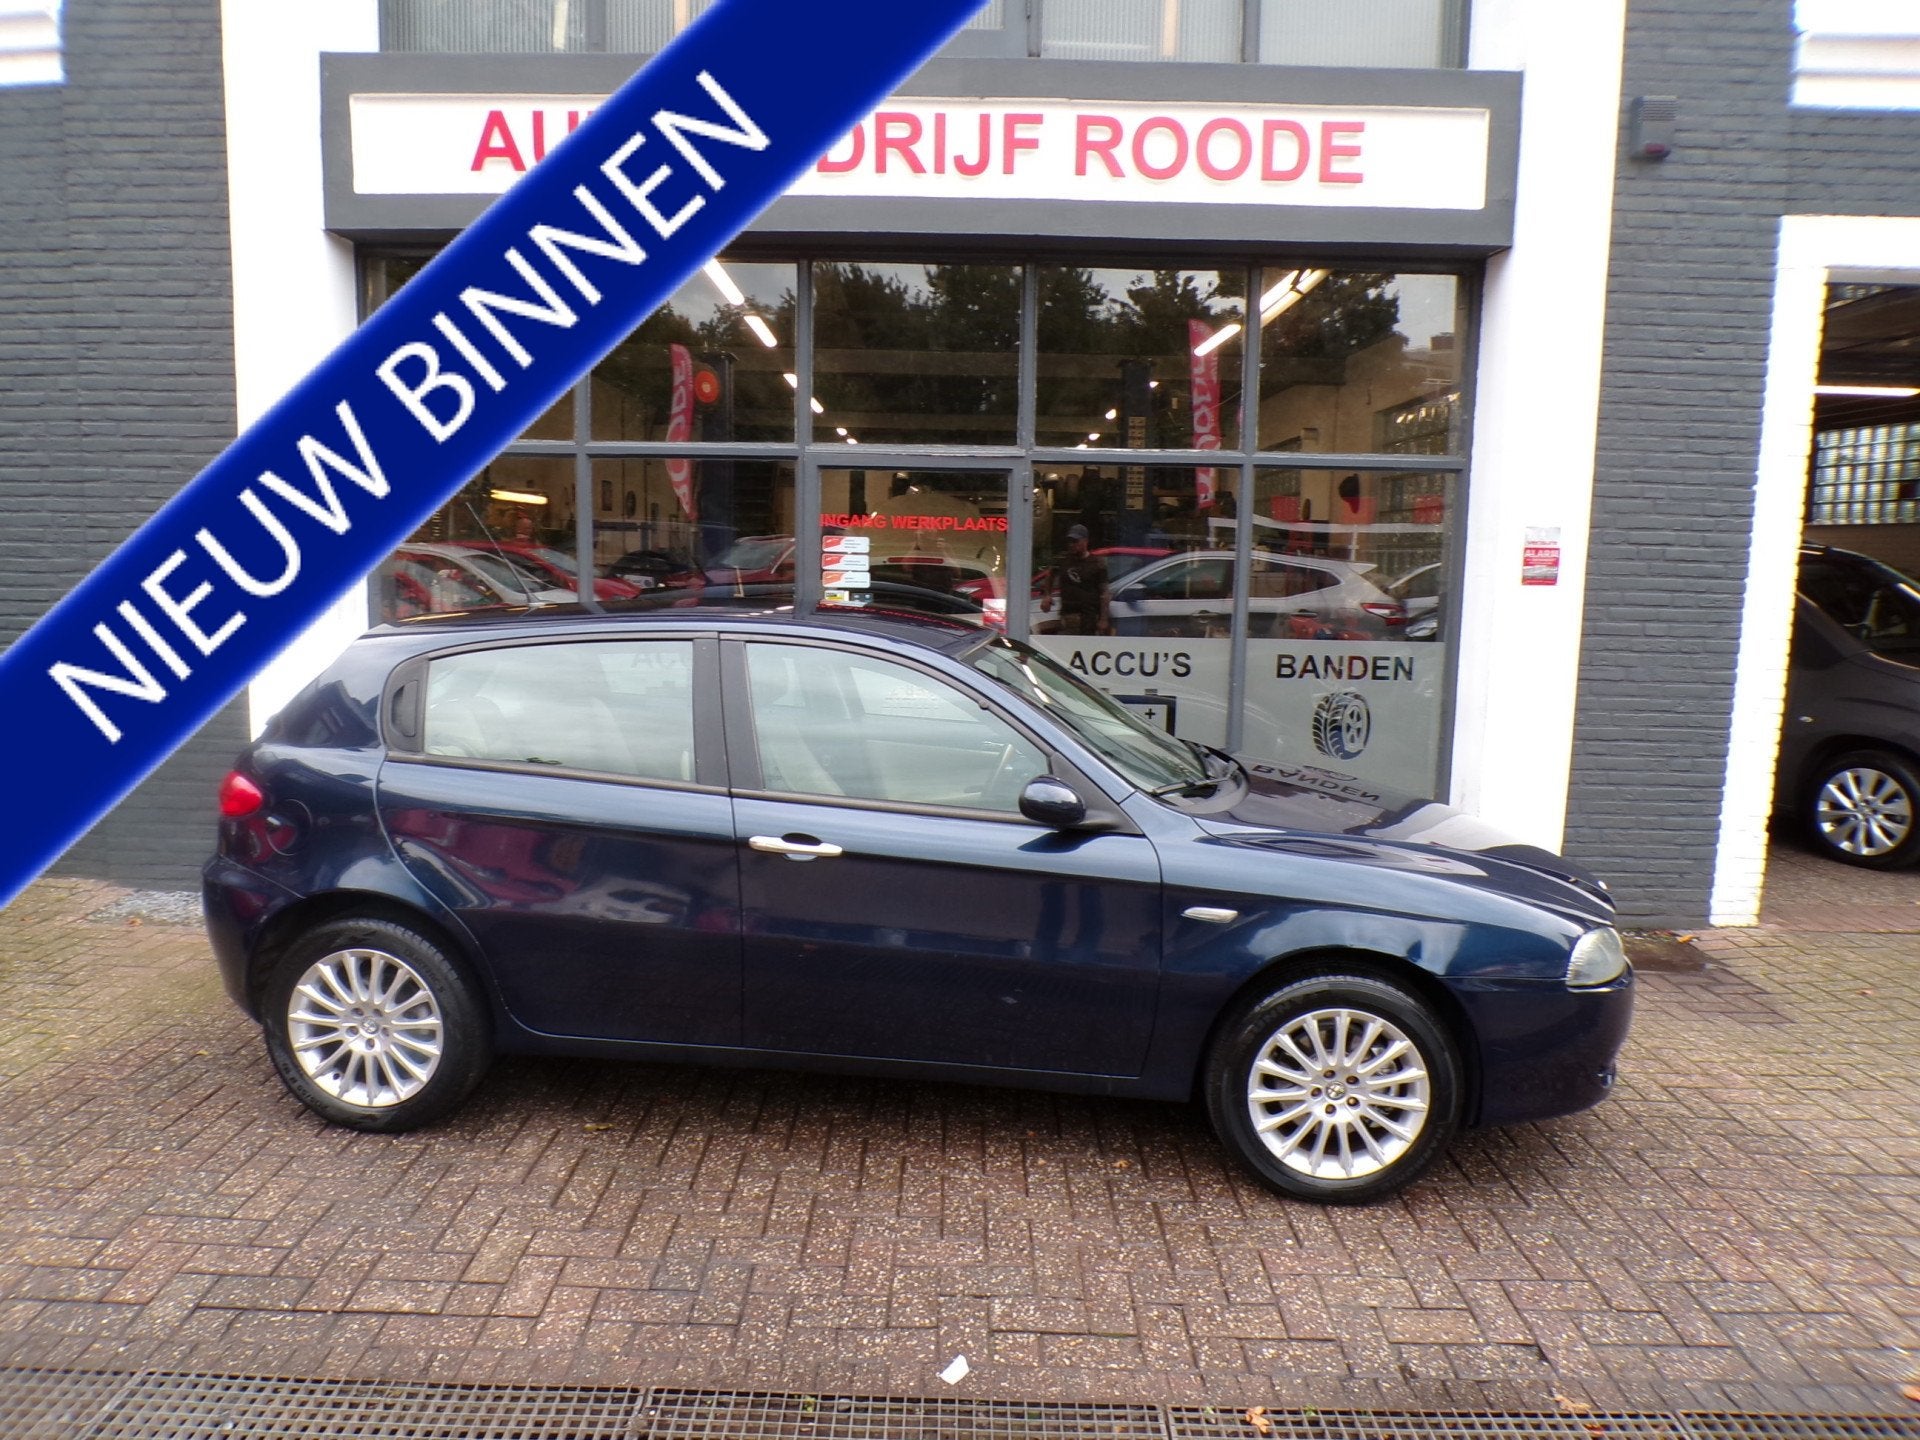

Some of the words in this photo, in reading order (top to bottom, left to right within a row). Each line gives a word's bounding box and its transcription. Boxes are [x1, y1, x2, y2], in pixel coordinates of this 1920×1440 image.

[1075, 114, 1366, 184] ROODE
[819, 513, 887, 529] INGANG
[891, 515, 1008, 532] WERKPLAATS
[1070, 650, 1192, 679] ACCU'S
[1276, 653, 1415, 681] BANDEN
